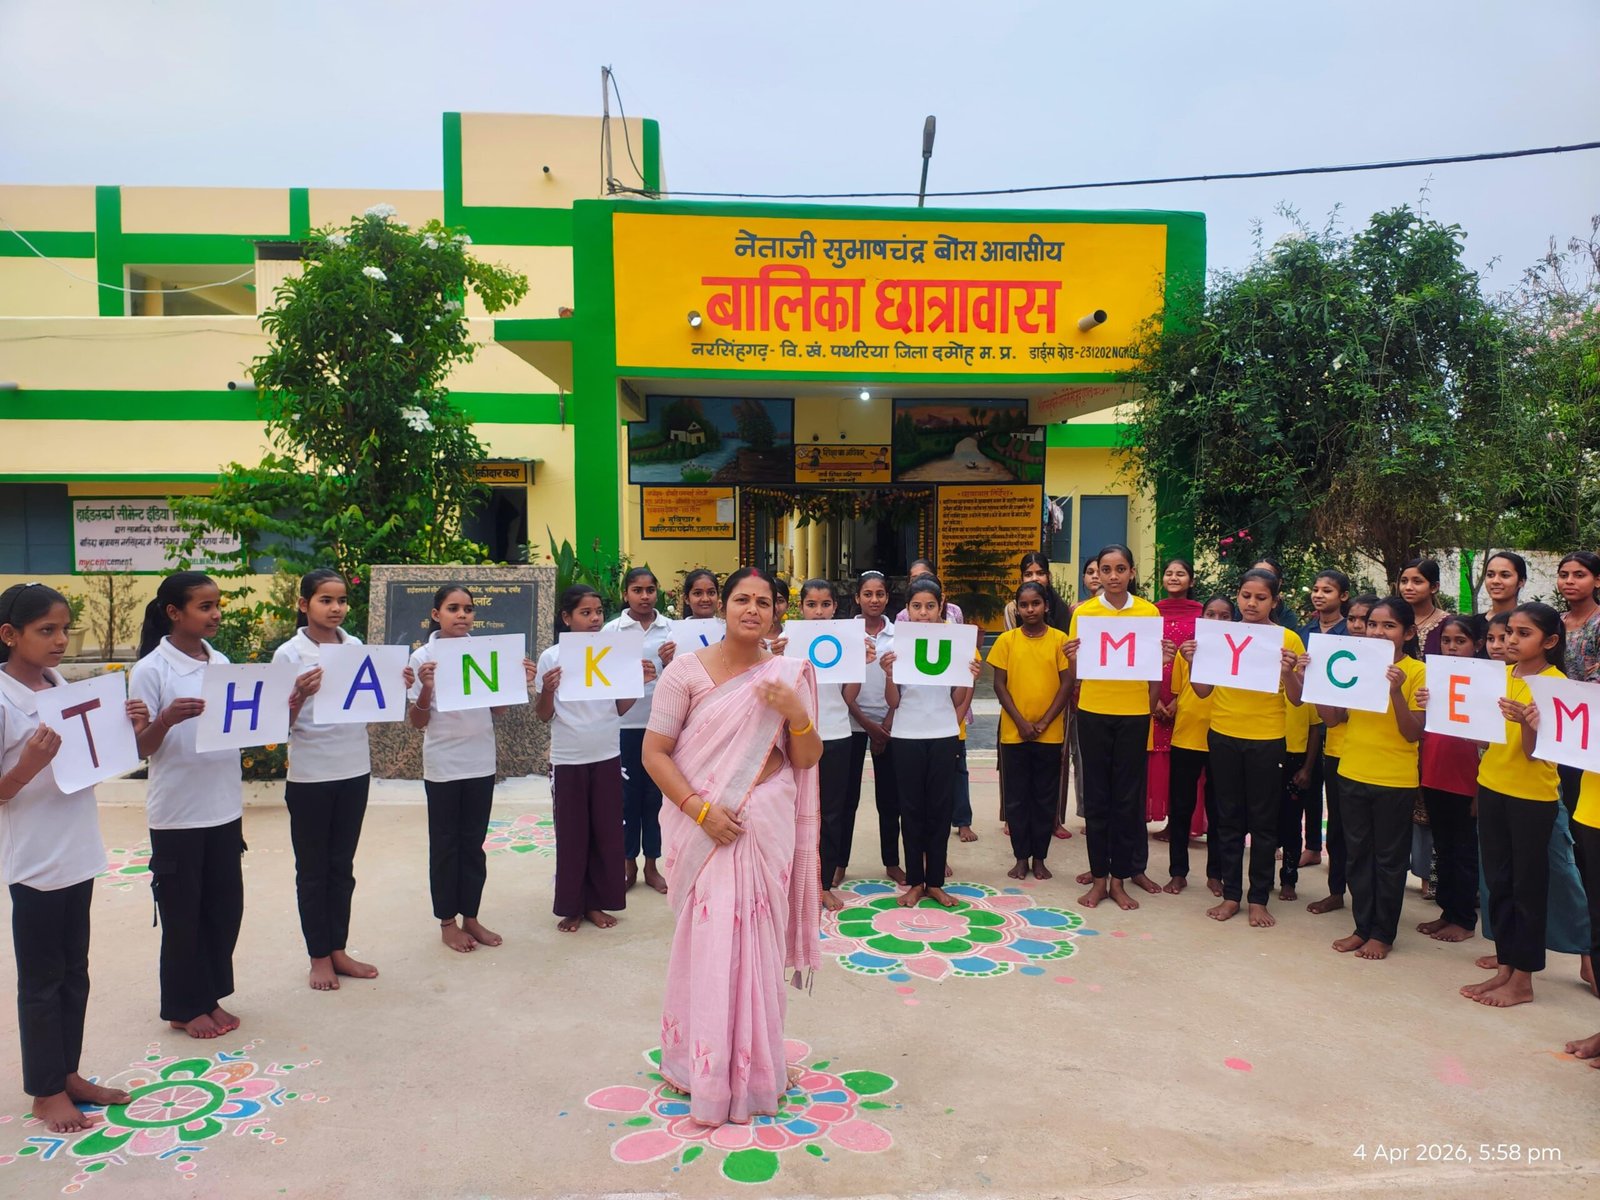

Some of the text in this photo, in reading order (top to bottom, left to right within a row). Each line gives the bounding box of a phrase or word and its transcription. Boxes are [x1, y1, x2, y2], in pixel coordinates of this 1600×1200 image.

[735, 229, 1065, 269] नेताजी सुभाषचंद्र बोस आवासीय
[701, 264, 1062, 335] बालिका छात्रावास
[830, 340, 889, 360] पथरिया
[894, 341, 928, 360] जिला
[932, 341, 976, 366] दमोह
[1029, 342, 1056, 363] डाईस
[146, 505, 169, 523] इंडिया
[584, 646, 612, 687] K
[808, 634, 843, 669] O
[914, 638, 952, 676] U
[1100, 631, 1136, 667] M
[1224, 633, 1254, 676] Y
[1326, 649, 1359, 689] C
[342, 654, 386, 710] A
[462, 651, 499, 695] N
[223, 681, 264, 734] H
[1448, 674, 1471, 724] E
[61, 698, 100, 769] T
[1552, 696, 1590, 750] M
